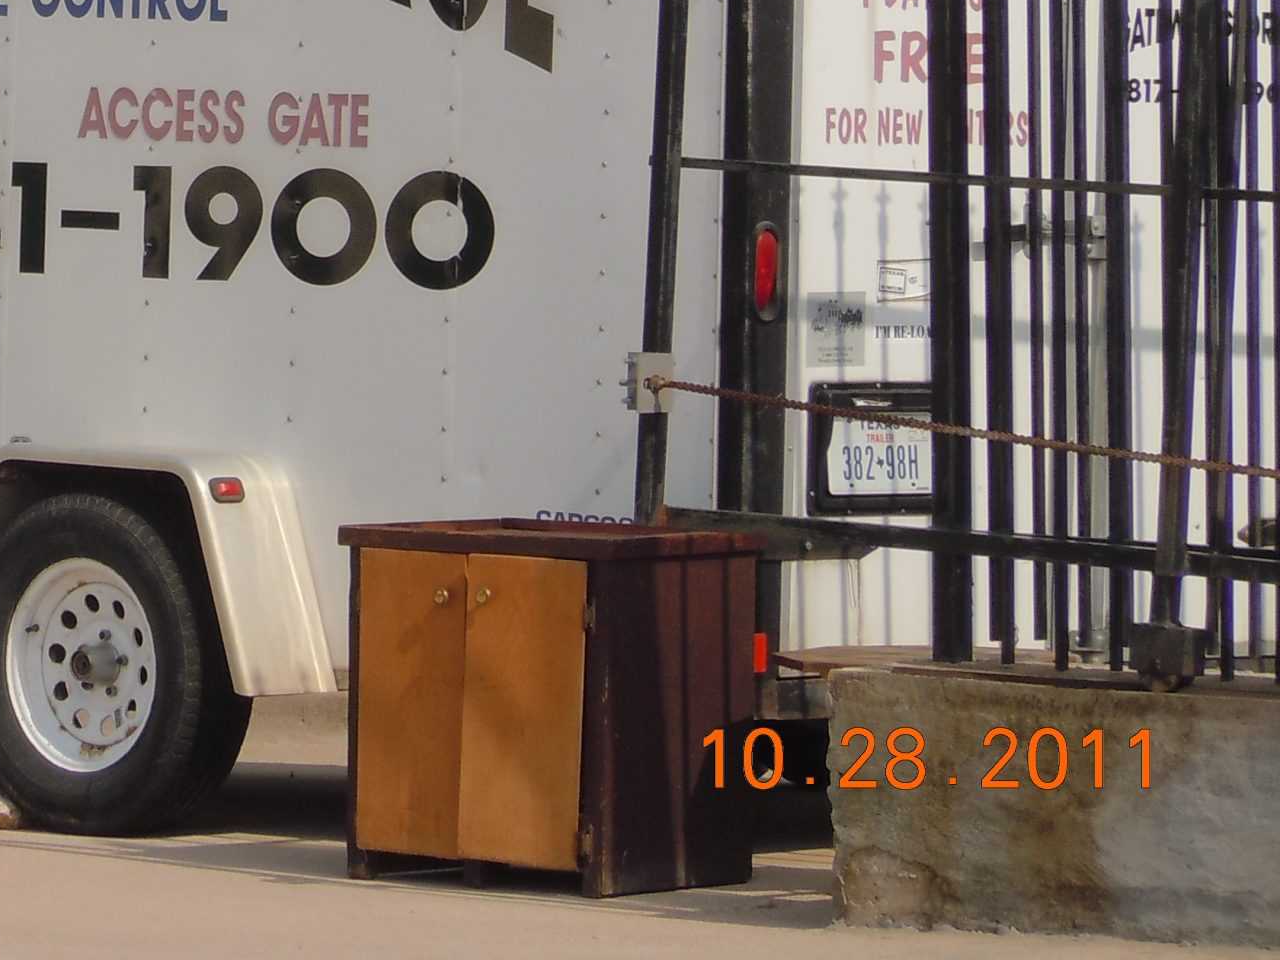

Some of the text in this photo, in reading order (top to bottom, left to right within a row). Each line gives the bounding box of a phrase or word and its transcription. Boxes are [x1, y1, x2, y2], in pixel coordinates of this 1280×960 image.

[872, 29, 986, 84] FRE
[77, 87, 369, 147] ACCESS GATE
[825, 107, 867, 145] FOR
[877, 106, 923, 146] NEW
